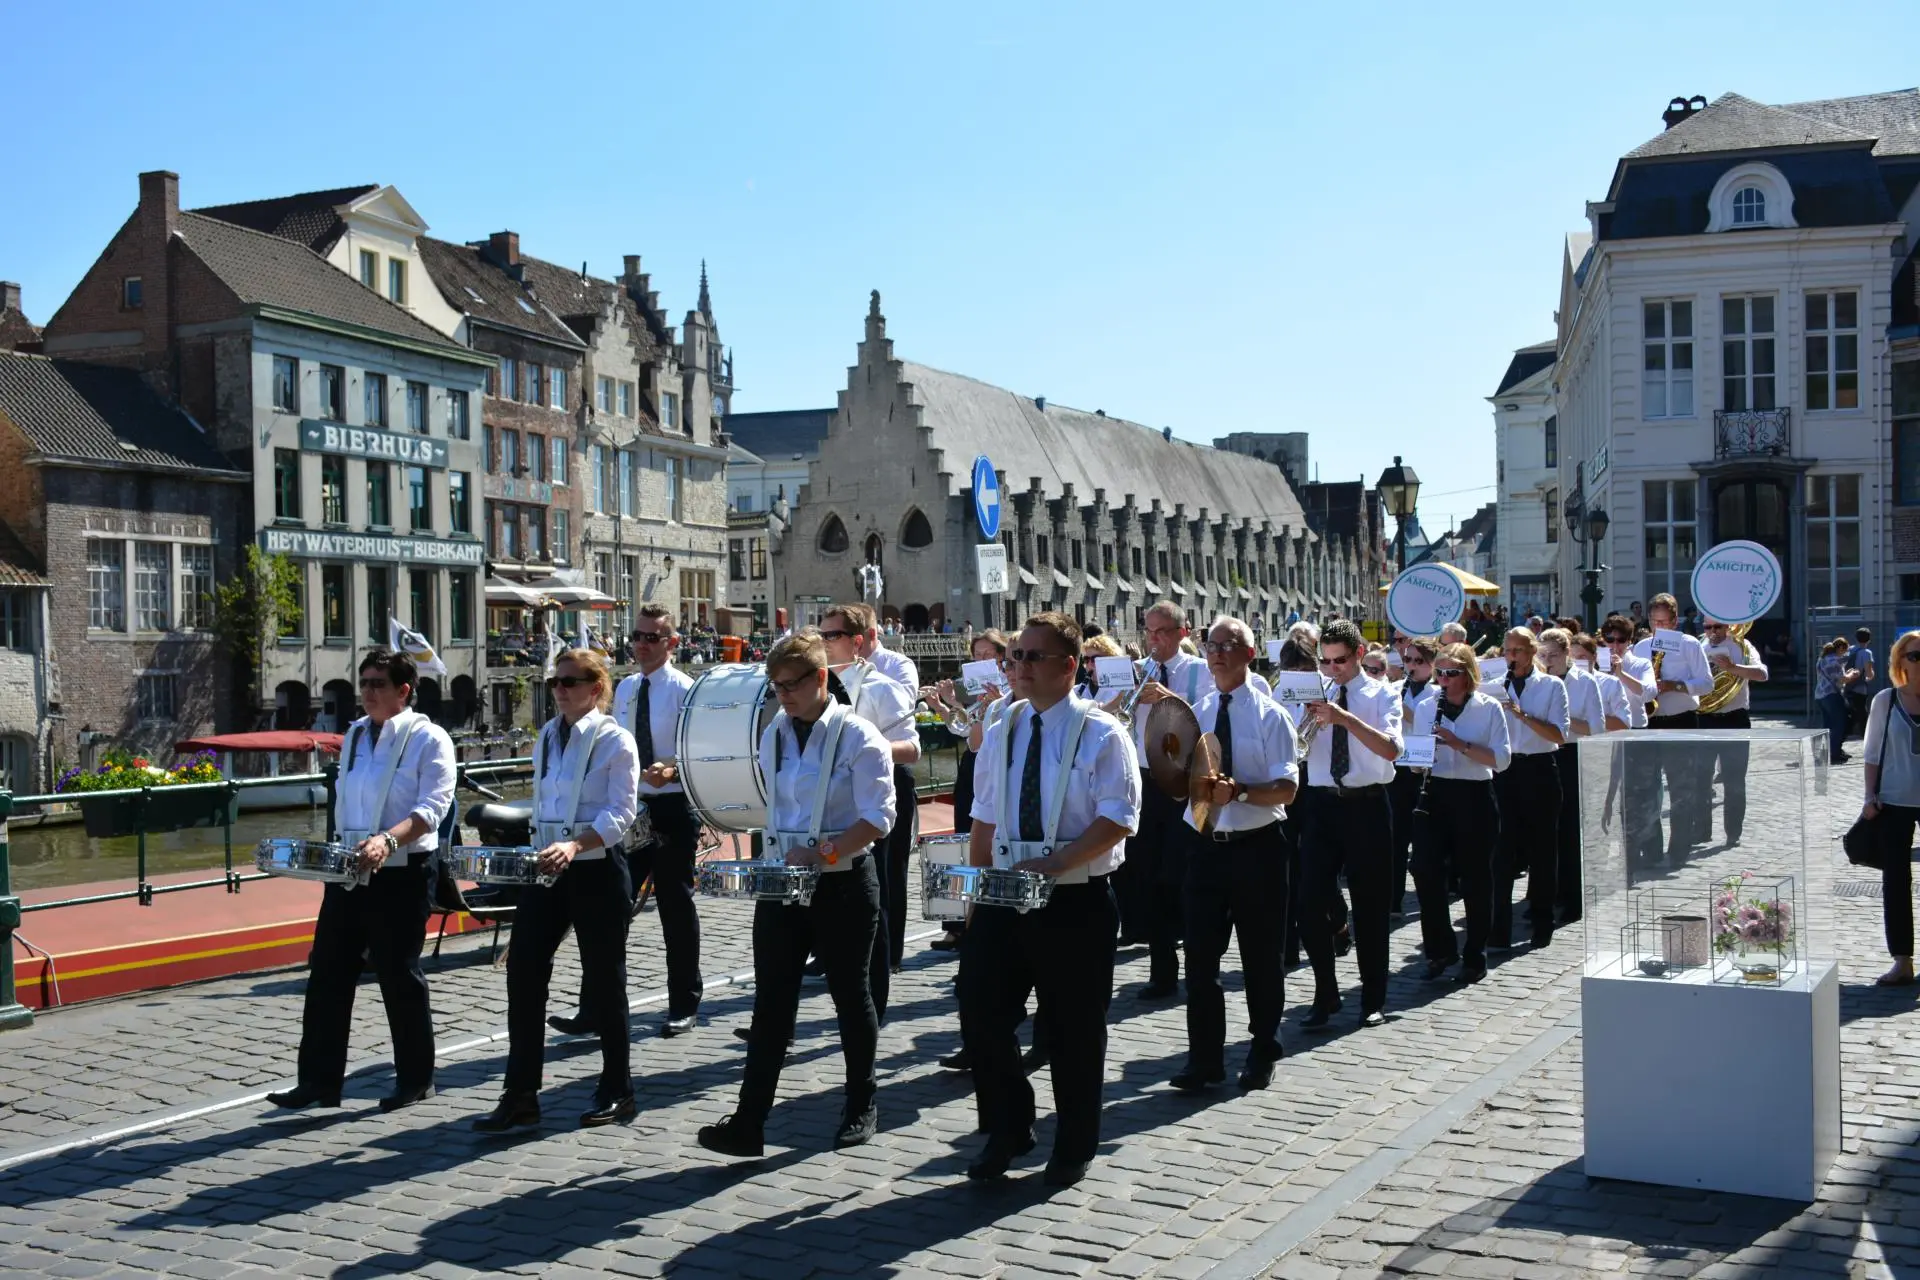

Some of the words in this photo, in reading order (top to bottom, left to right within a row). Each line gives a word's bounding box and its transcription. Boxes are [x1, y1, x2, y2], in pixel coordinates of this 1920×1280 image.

[324, 426, 433, 461] BIERHUIS
[266, 530, 301, 550] HET
[304, 533, 400, 557] WATERHUIS
[414, 541, 484, 561] BIERKANT
[1706, 561, 1765, 573] AMICITIA
[1404, 575, 1453, 597] AMICITIA
